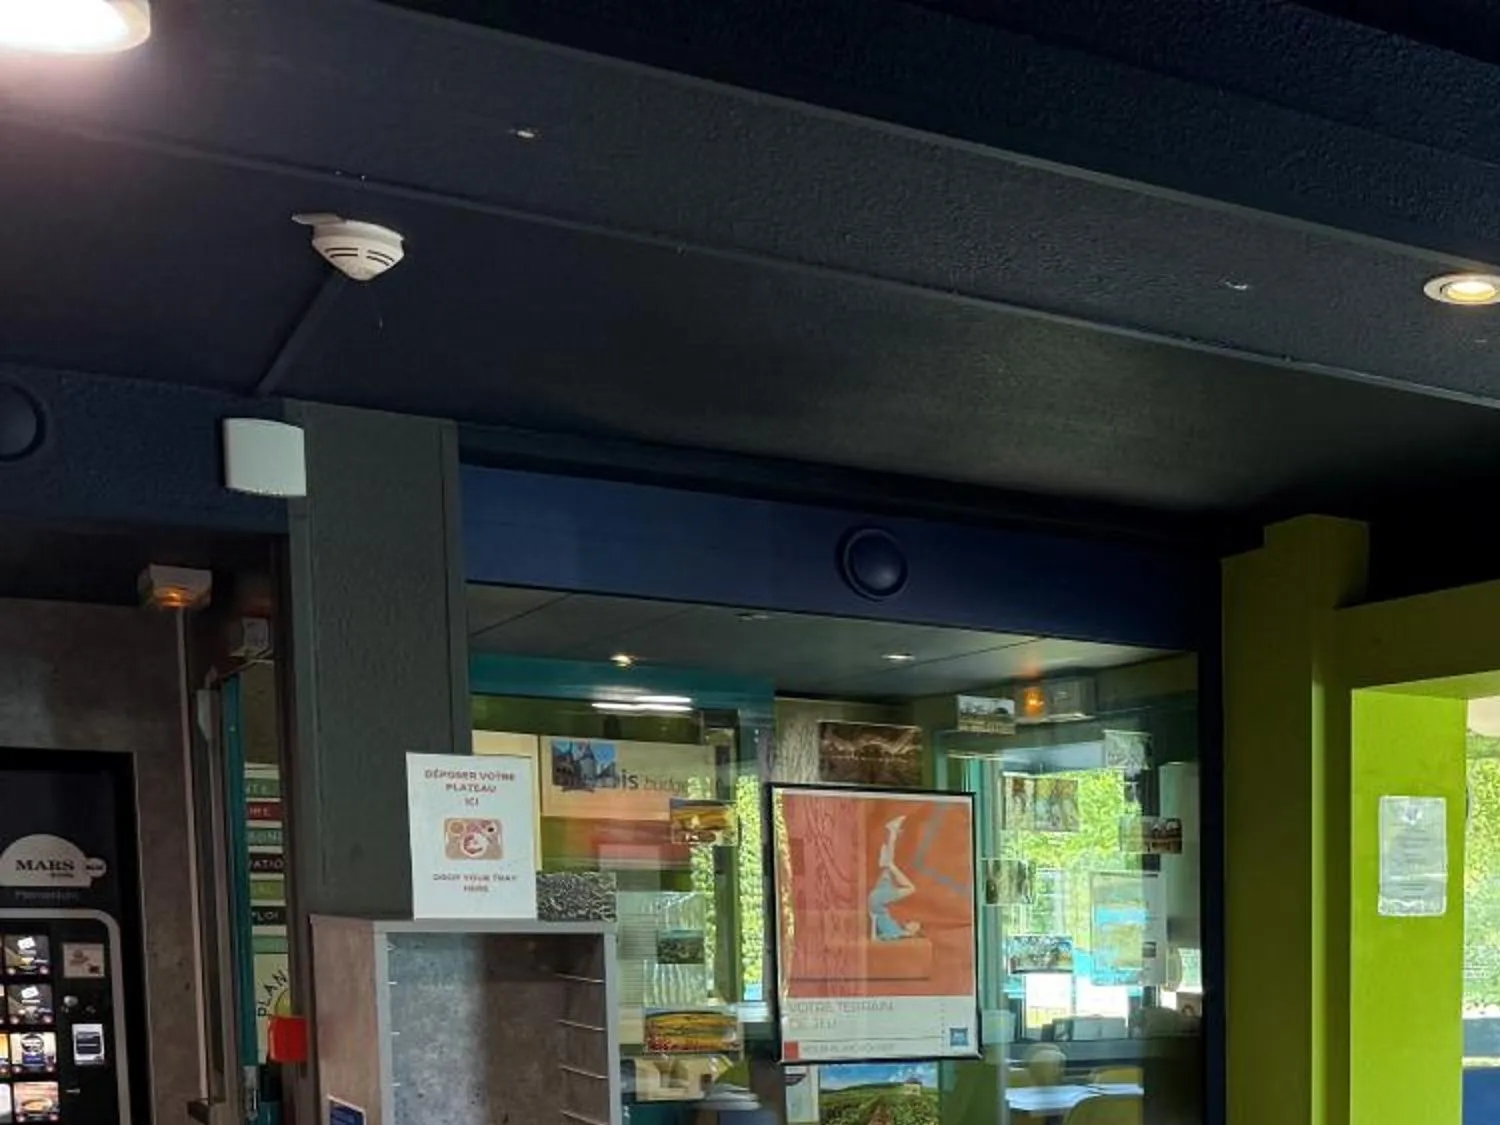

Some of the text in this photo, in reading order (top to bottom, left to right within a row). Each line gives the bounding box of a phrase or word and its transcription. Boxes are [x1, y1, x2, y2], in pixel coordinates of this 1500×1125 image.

[424, 768, 516, 782] DÉPOSER VOTRE
[445, 783, 497, 794] PLATEAU
[465, 797, 480, 807] ICI
[15, 859, 76, 872] MARS
[788, 1000, 895, 1014] VOTRE TERRAIN
